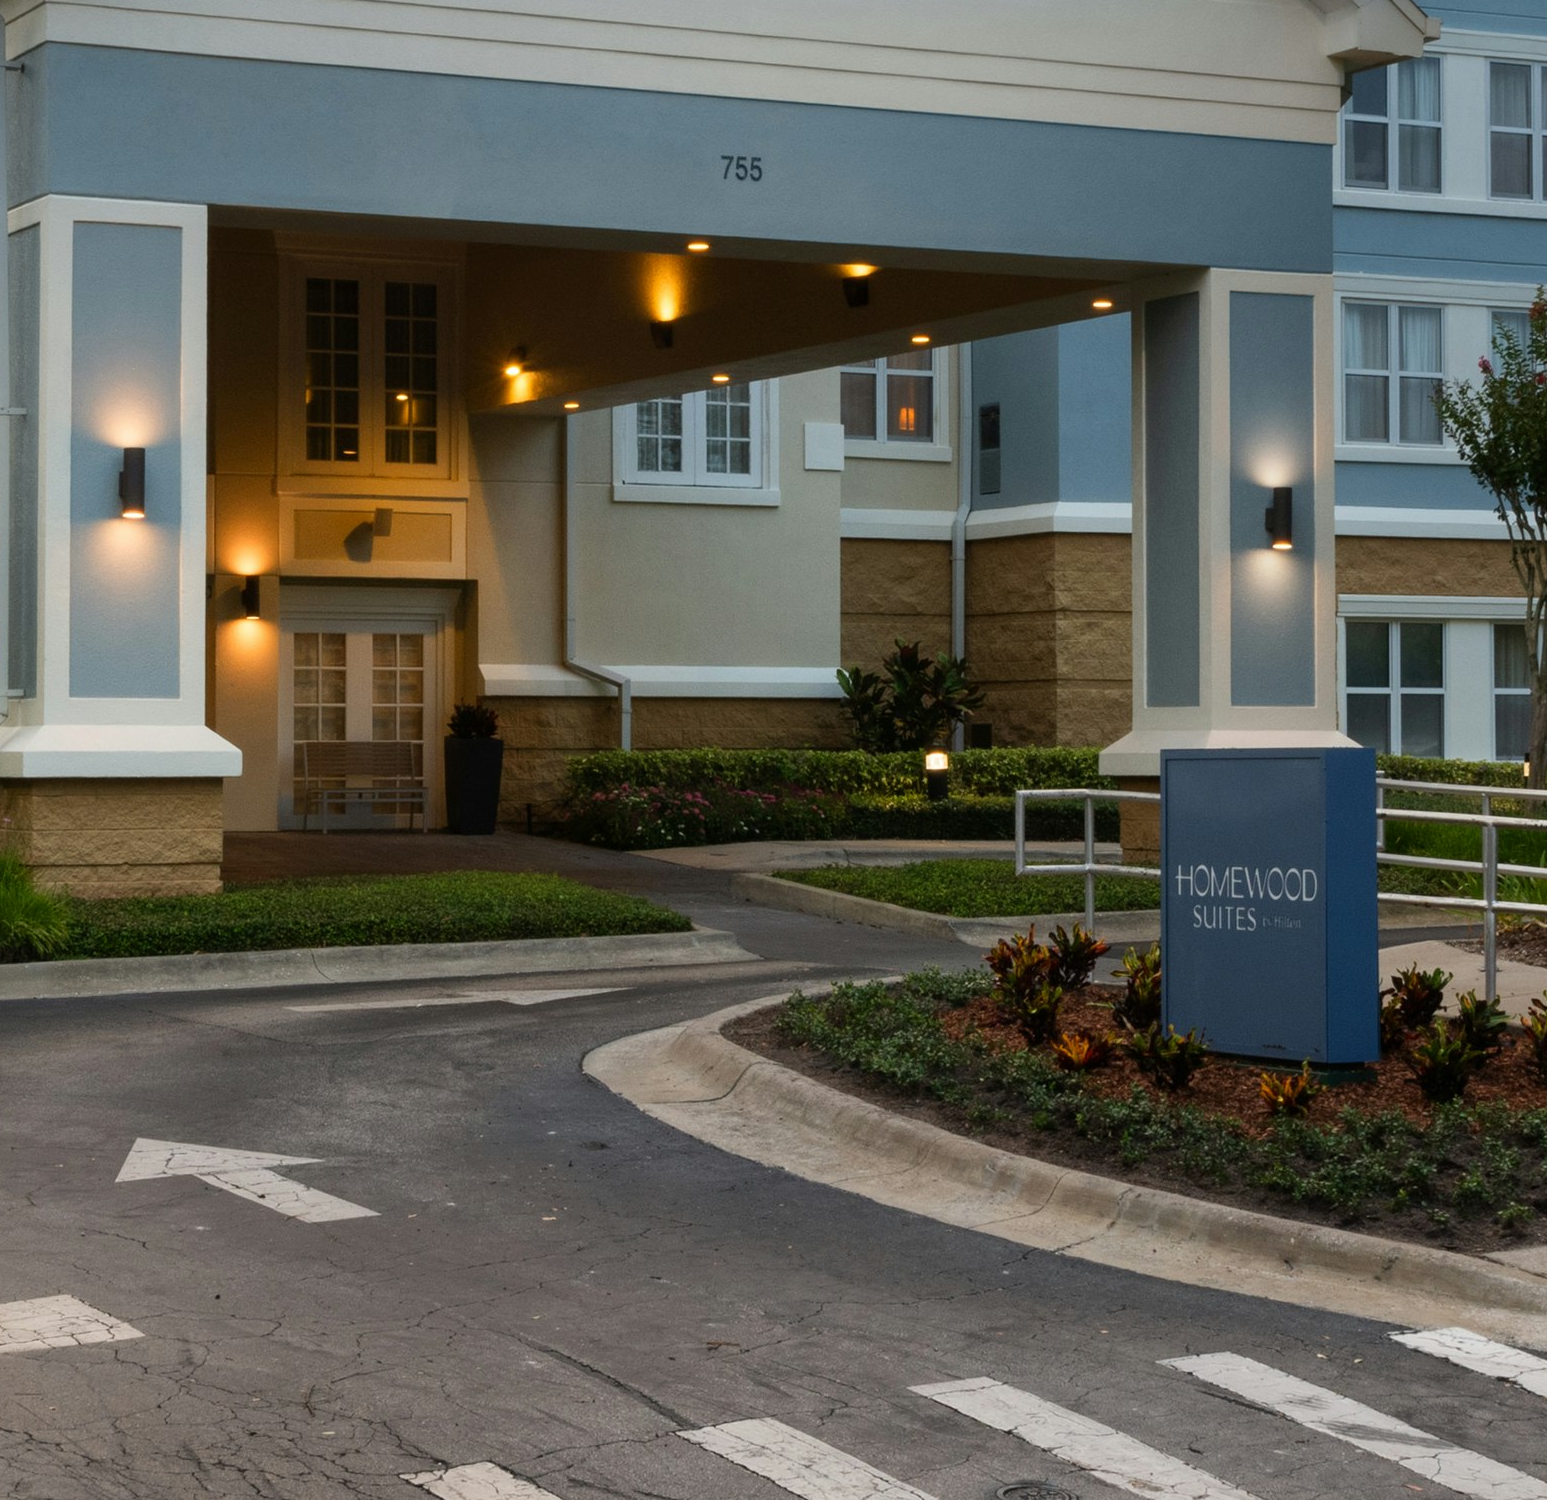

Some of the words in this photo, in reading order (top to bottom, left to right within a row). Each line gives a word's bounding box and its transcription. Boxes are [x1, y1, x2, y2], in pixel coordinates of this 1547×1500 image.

[720, 155, 763, 182] 755
[1175, 864, 1318, 901] HOMEWOOD
[1193, 904, 1257, 931] SUITES
